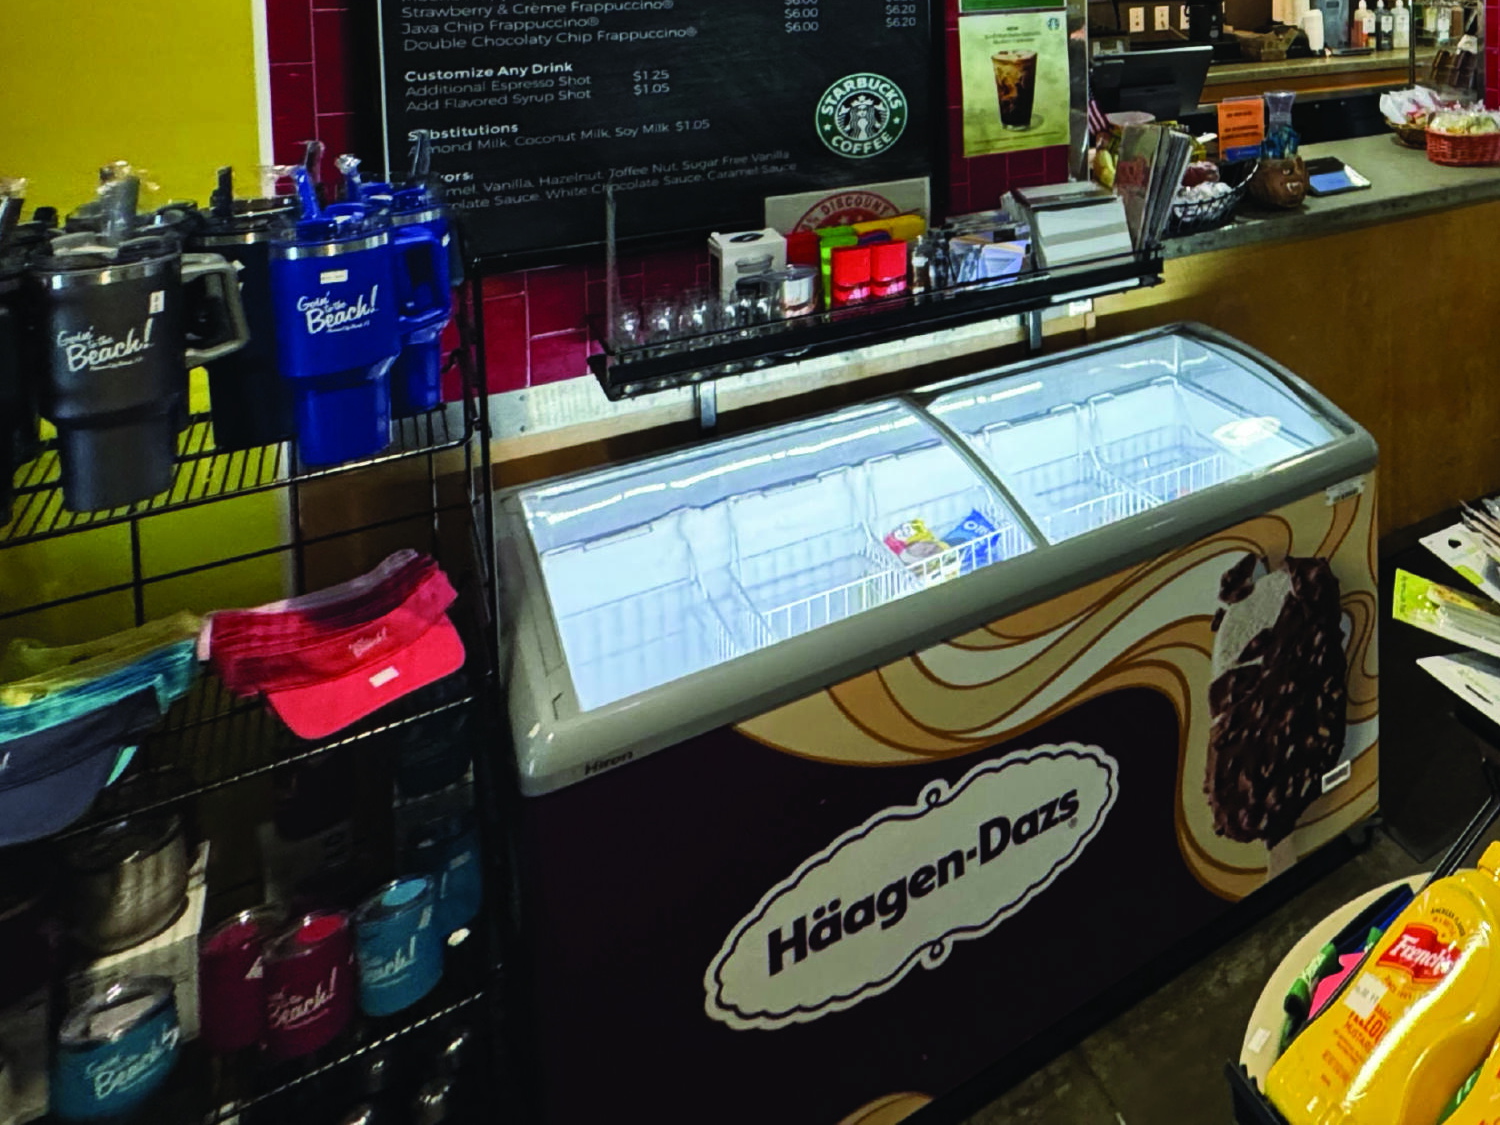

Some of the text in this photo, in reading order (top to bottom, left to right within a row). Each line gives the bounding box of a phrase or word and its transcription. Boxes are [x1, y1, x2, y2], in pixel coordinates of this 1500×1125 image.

[402, 6, 492, 18] Strawberry
[497, 3, 507, 15] &
[403, 22, 439, 34] Java
[444, 21, 484, 33] Chip
[405, 38, 466, 51] Double
[472, 34, 552, 47] Chocolaty
[556, 32, 592, 43] Chip
[405, 62, 572, 81] Customize Any Drink
[406, 69, 669, 96] Additional Espresso Shot $1.25
[406, 82, 670, 111] Add Flavored Syrup Shot $1.05
[820, 76, 903, 116] STARBUCKS
[408, 124, 518, 141] Sbstitutions
[830, 131, 894, 155] COFFEE
[820, 195, 890, 215] DISCOUNT
[306, 284, 379, 335] Beach!
[66, 317, 155, 372] Beach!
[766, 786, 1082, 978] Häagen-Dazs
